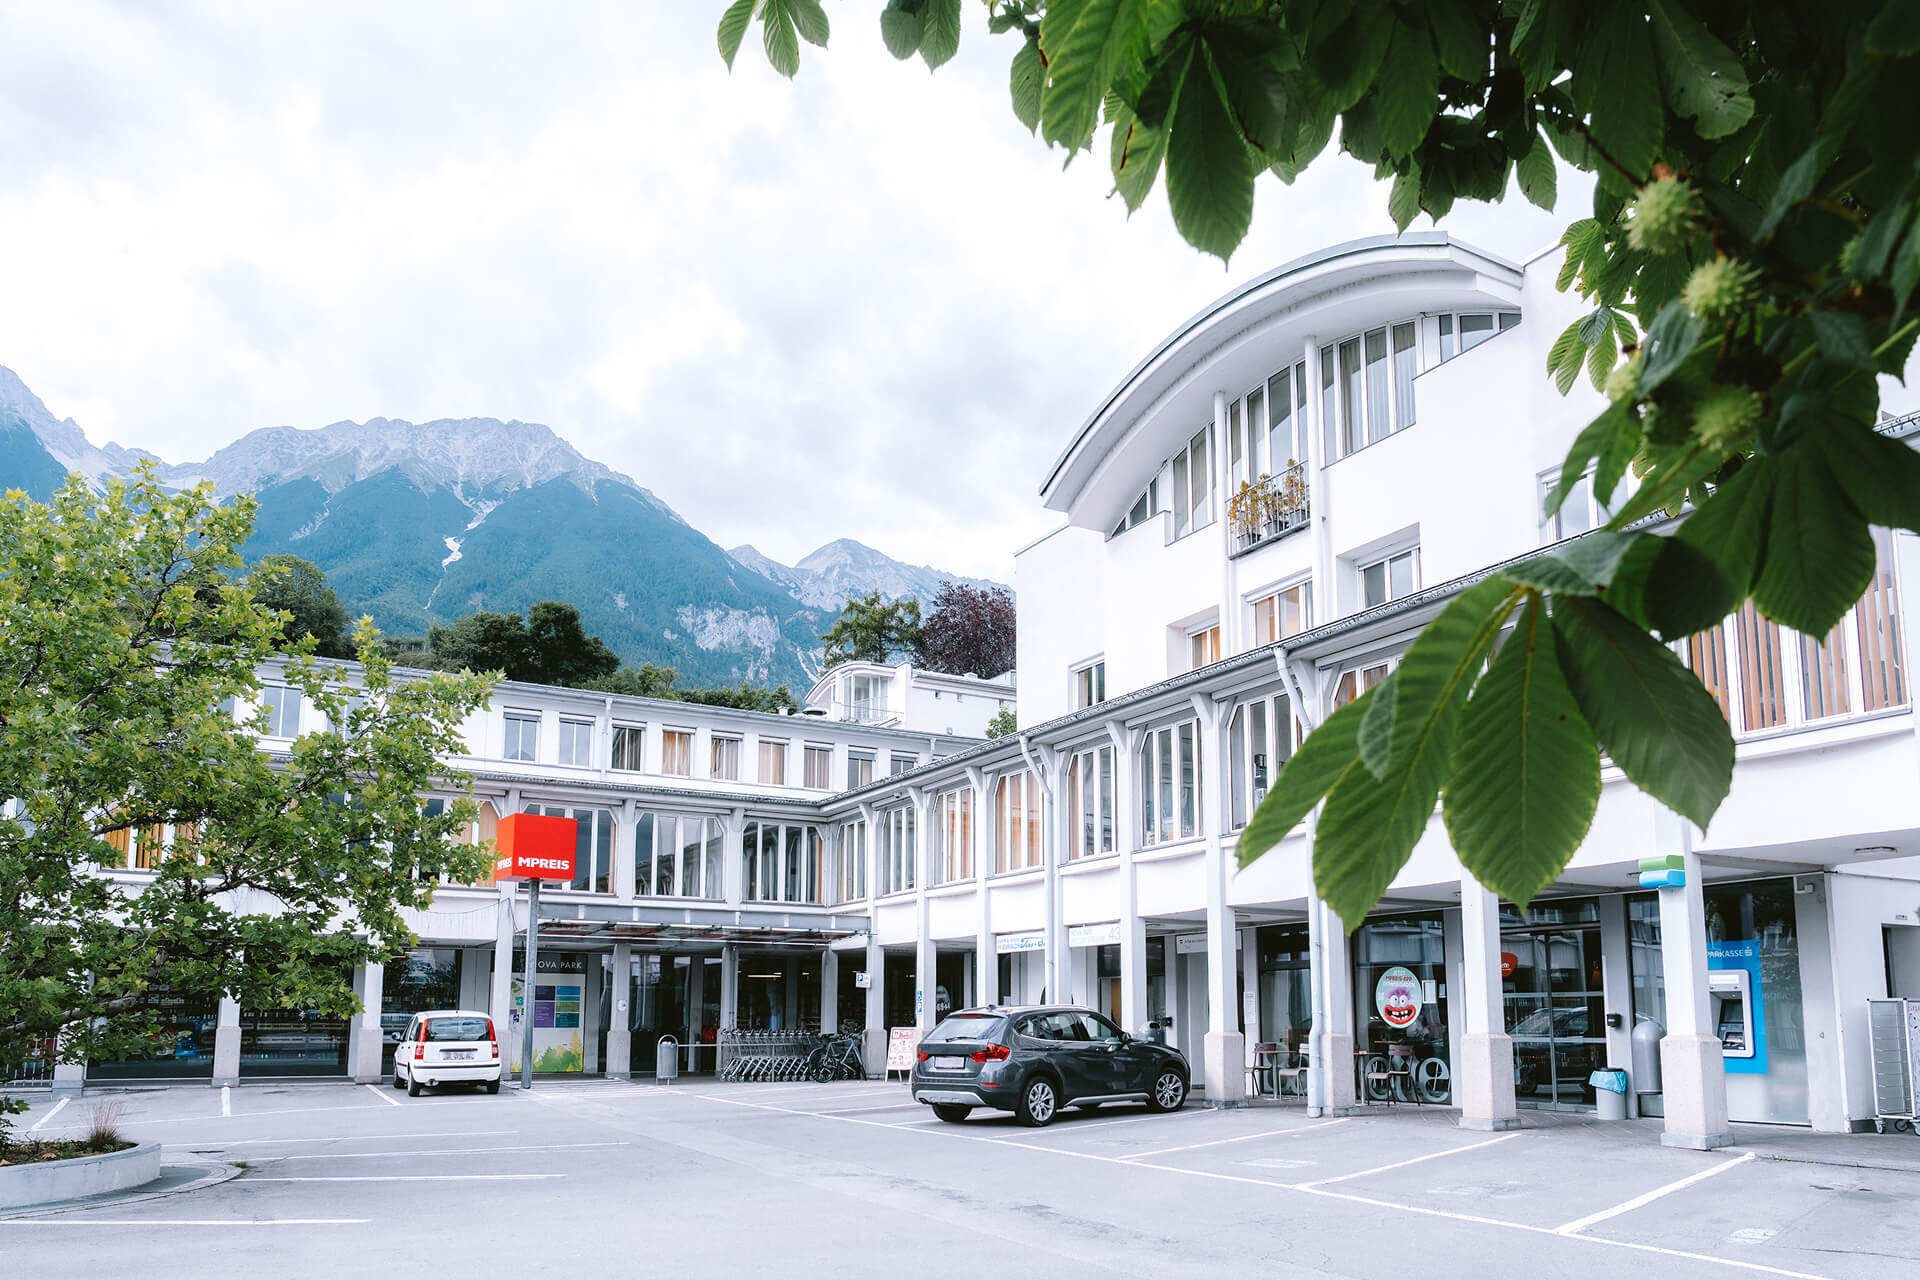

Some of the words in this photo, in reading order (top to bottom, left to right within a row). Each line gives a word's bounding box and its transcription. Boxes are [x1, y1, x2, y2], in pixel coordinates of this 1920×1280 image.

[518, 856, 570, 870] MPREIS
[1707, 949, 1744, 958] PARKASSE
[536, 960, 557, 969] OVA
[560, 961, 582, 969] PARK
